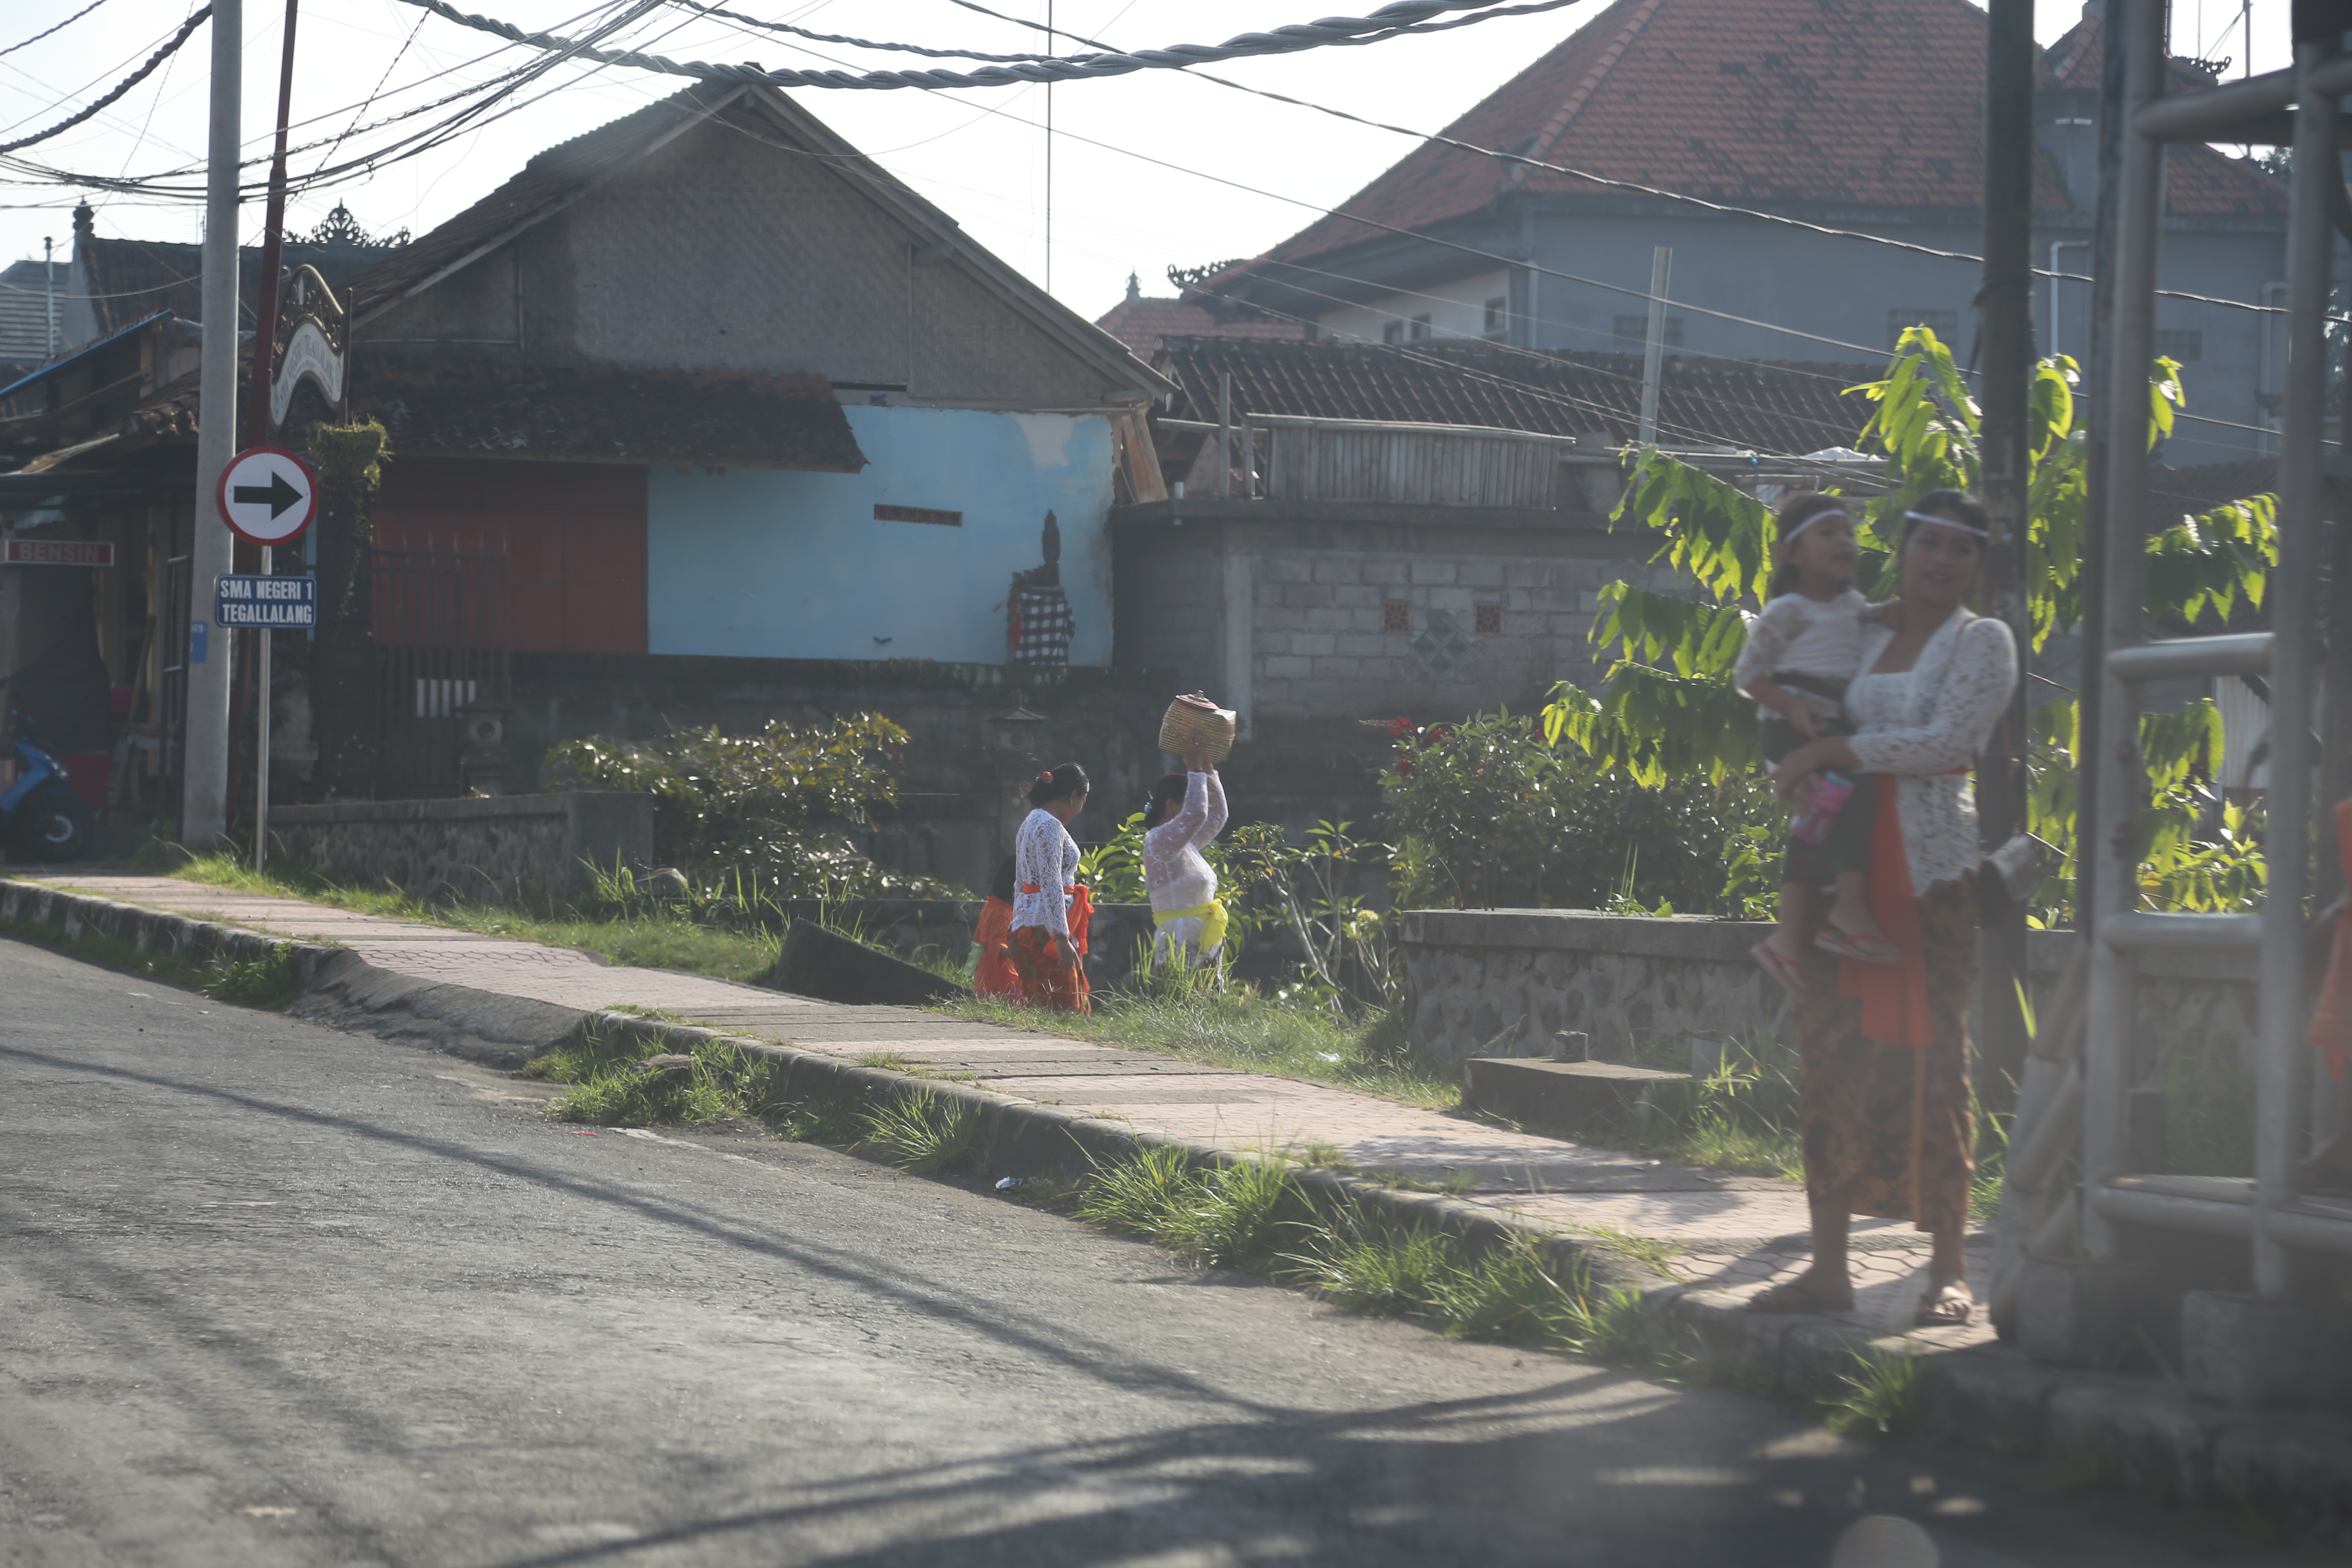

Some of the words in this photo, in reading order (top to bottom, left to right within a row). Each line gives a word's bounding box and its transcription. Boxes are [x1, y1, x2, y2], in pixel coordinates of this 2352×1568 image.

[19, 543, 99, 562] BENSIN
[220, 580, 252, 599] SMA
[256, 581, 301, 600] NEGERI
[306, 581, 312, 600] 1
[222, 603, 312, 624] TEGALLALANG
